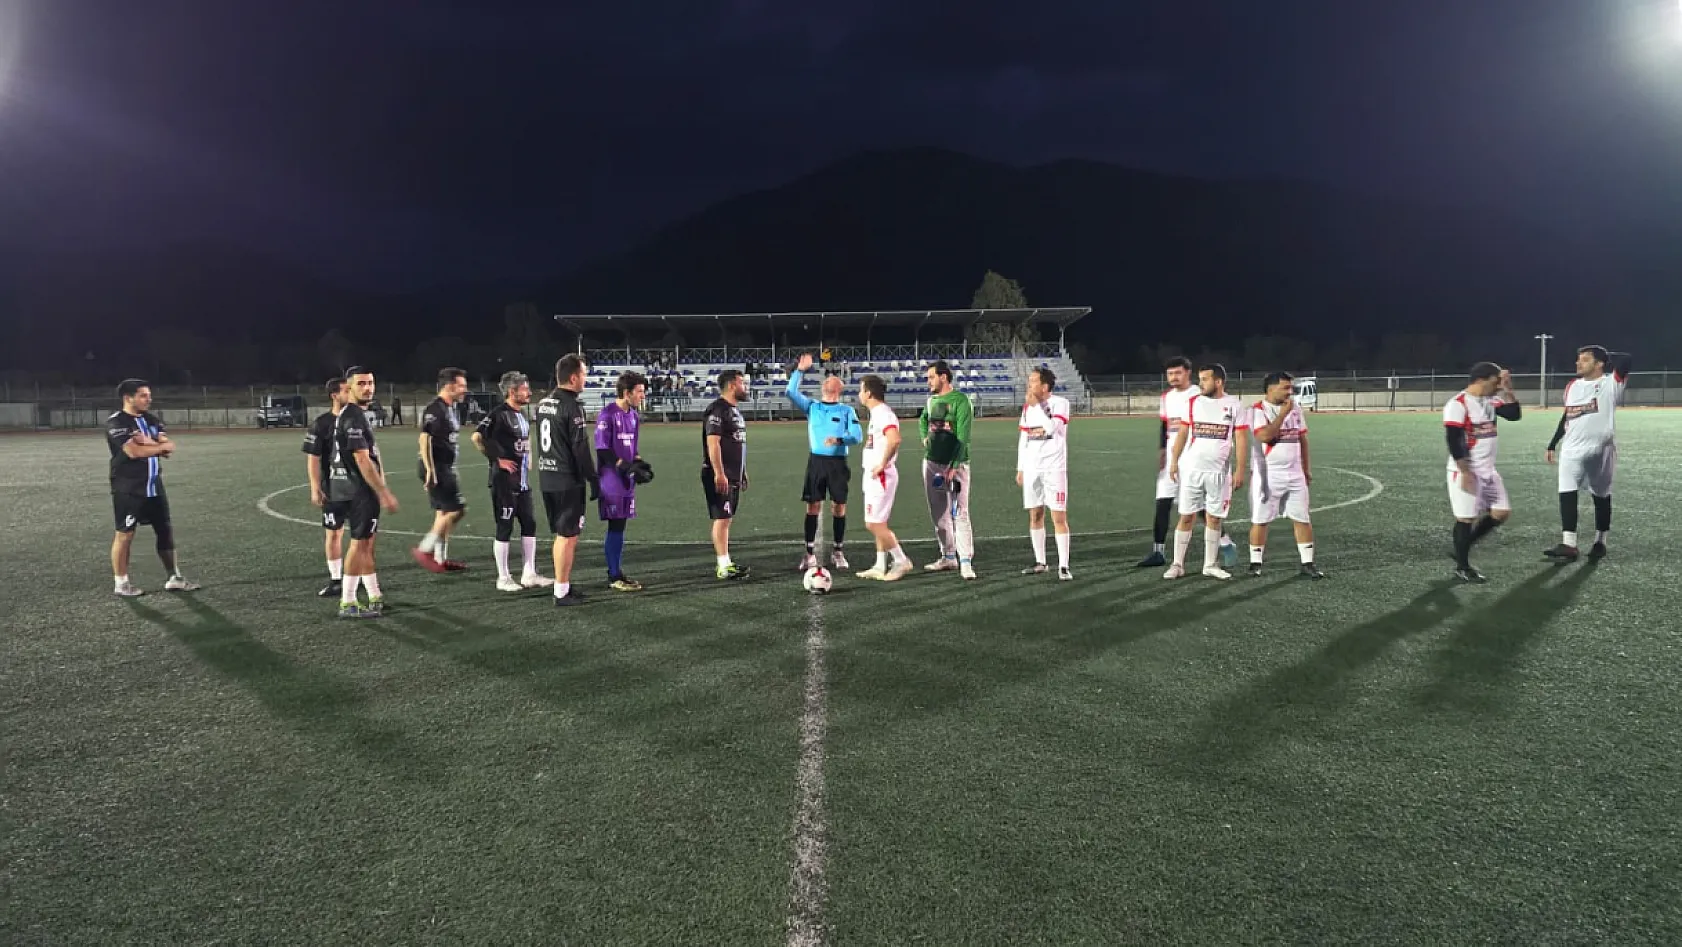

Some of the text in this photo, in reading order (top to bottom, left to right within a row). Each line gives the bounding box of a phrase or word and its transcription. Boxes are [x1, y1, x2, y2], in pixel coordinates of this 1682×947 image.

[540, 418, 551, 452] 8
[501, 507, 514, 520] 17
[723, 501, 731, 514] 4
[371, 518, 377, 533] 7
